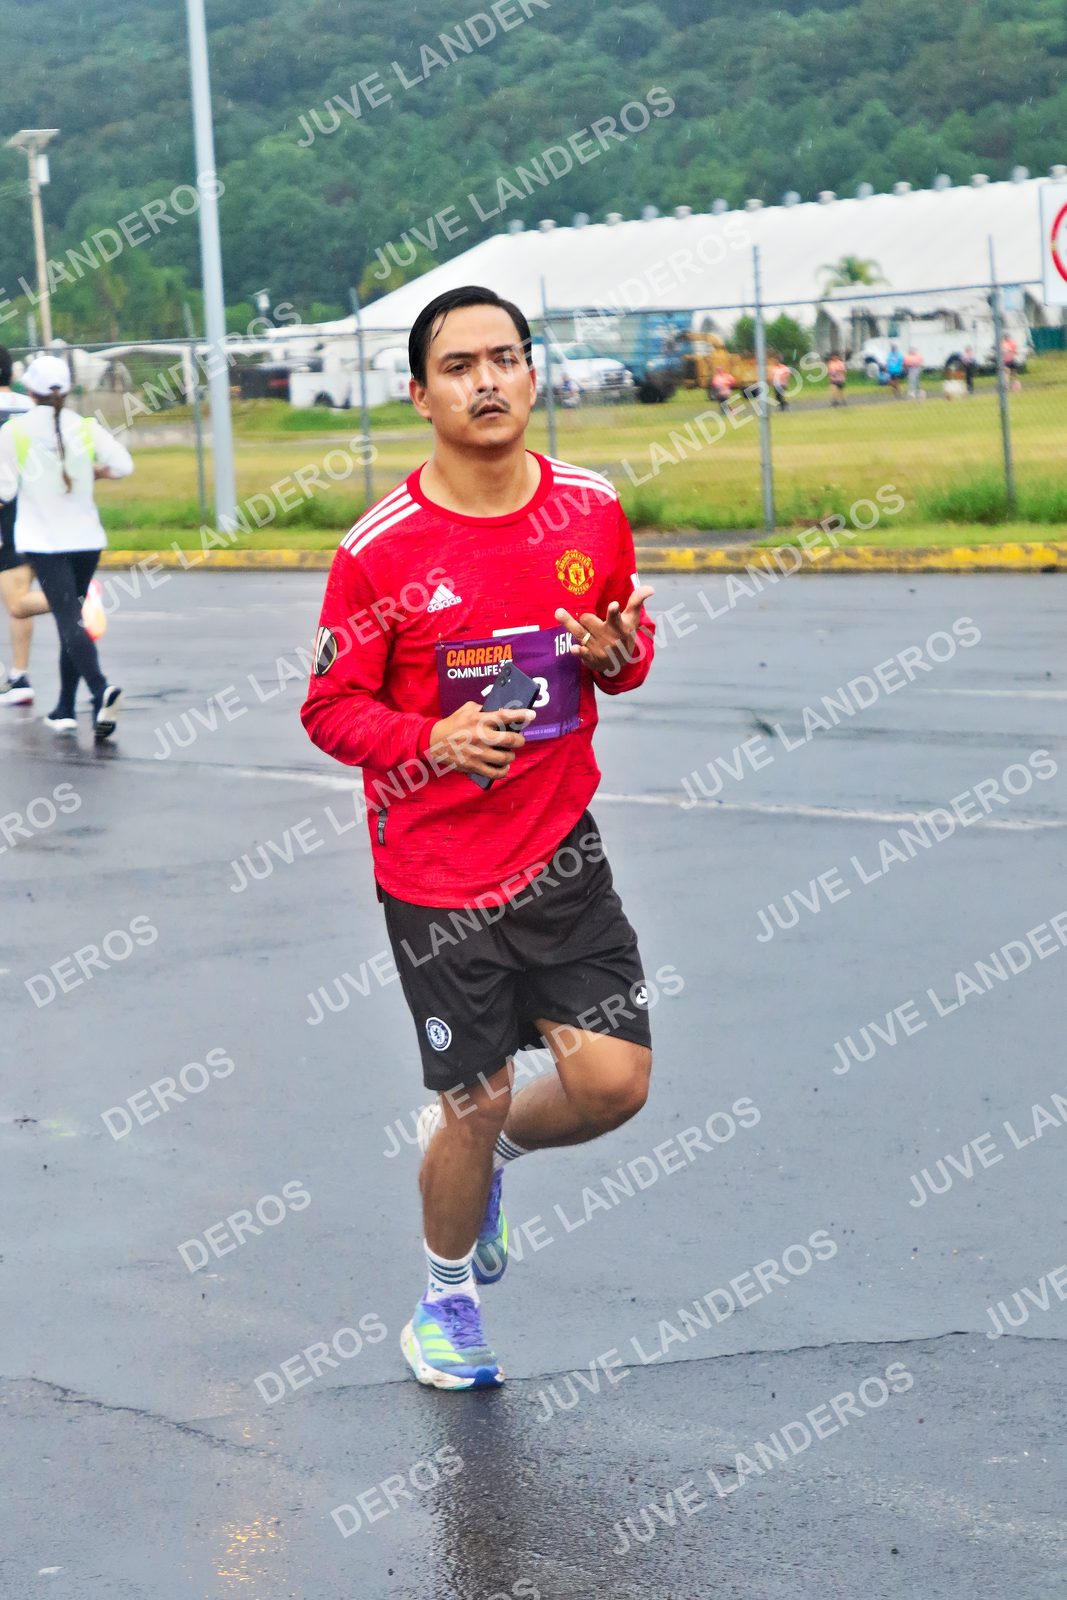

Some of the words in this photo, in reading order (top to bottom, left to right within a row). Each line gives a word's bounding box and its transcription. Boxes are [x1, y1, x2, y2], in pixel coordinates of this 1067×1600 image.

[427, 596, 462, 613] adidas
[555, 632, 573, 656] 15K
[446, 644, 513, 667] CARRERA
[447, 664, 499, 679] OMNILIFE
